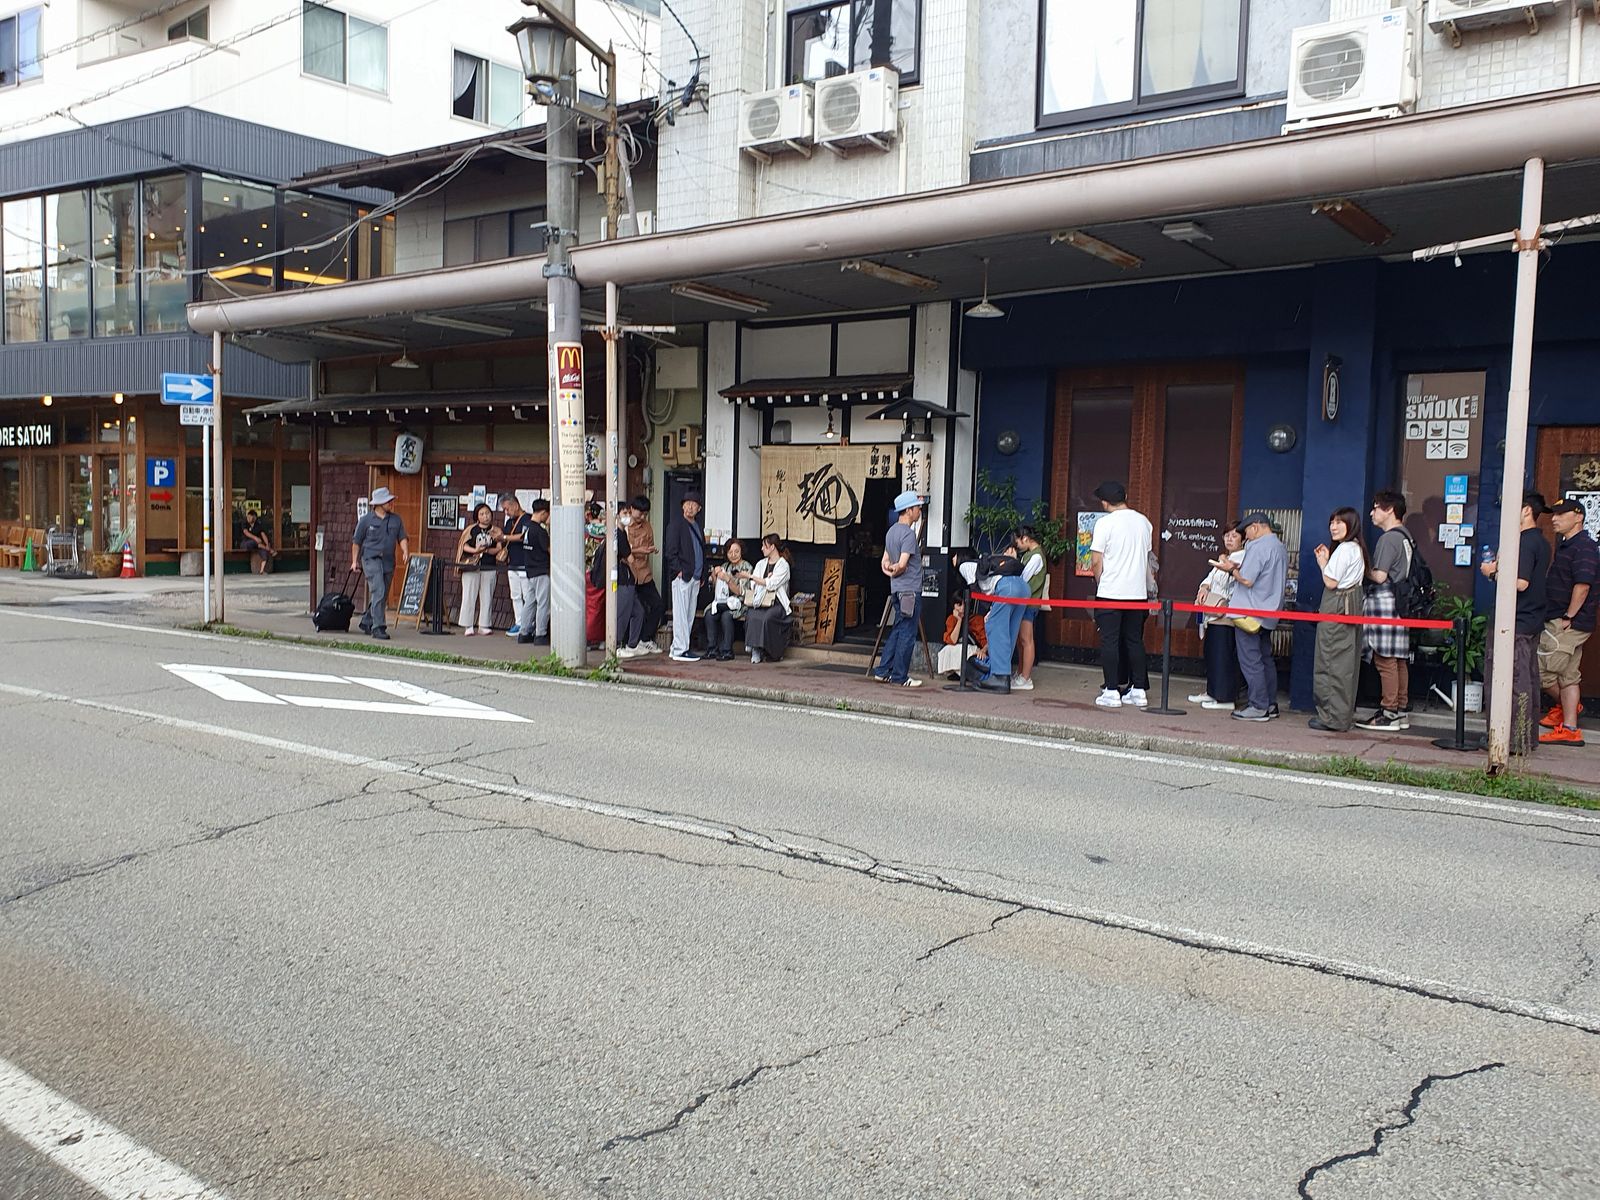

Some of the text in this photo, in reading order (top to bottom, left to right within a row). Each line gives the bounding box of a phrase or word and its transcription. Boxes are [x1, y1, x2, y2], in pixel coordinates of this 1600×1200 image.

[1405, 396, 1470, 420] SMOKE
[1407, 394, 1438, 405] YOU CAN
[17, 424, 51, 446] SATOH
[154, 466, 168, 486] P
[905, 443, 920, 492] 中華そば
[820, 567, 840, 634] 営業中
